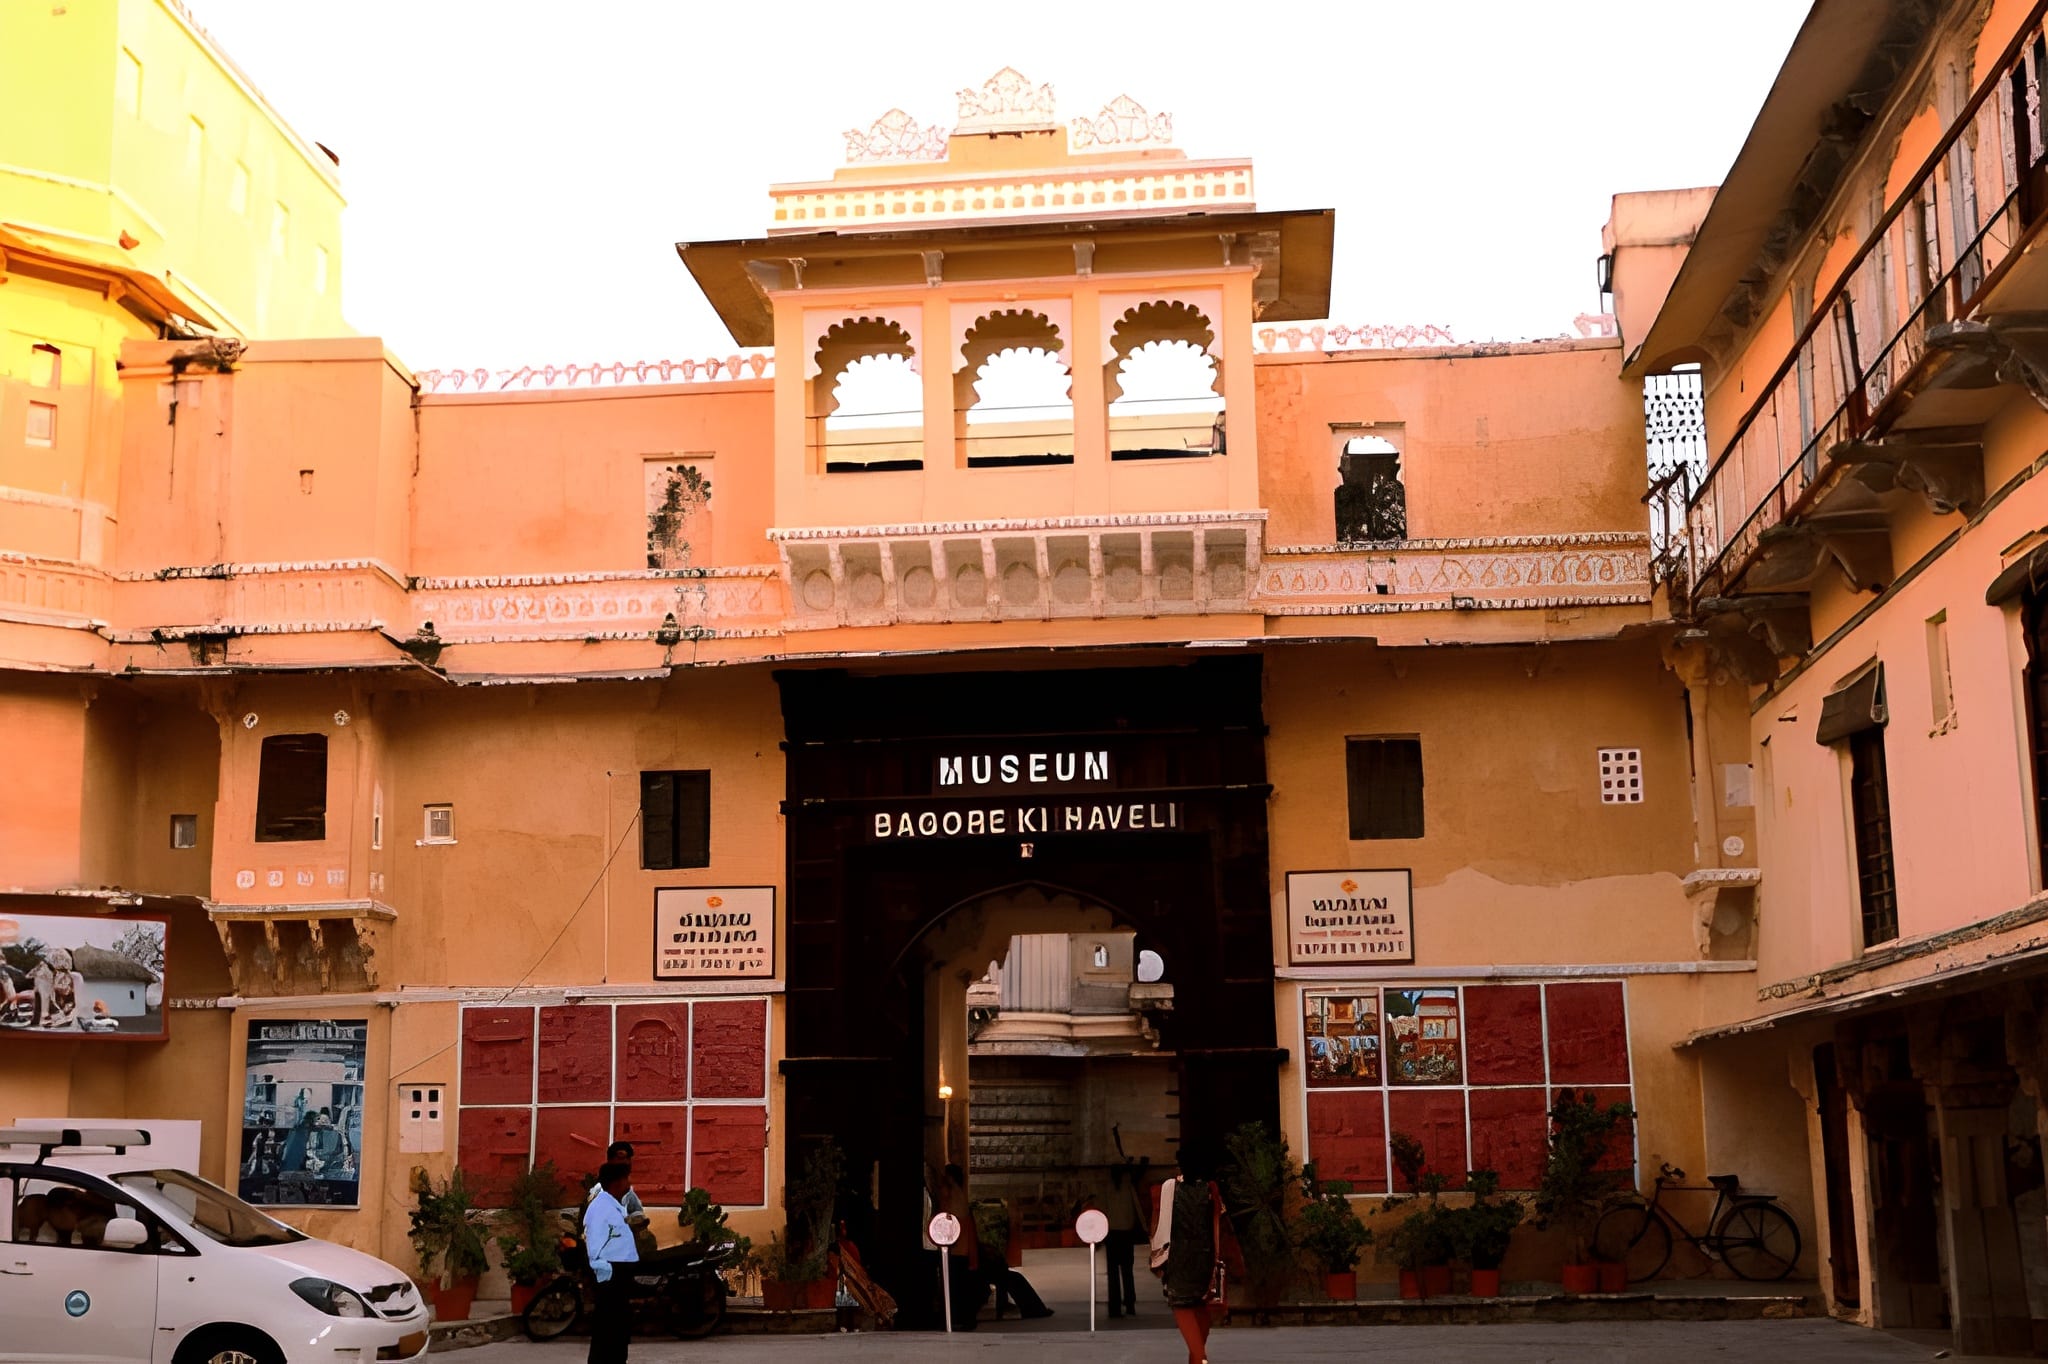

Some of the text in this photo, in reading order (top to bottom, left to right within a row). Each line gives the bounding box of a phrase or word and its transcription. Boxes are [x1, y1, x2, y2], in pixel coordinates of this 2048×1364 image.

[939, 750, 1109, 786] MUSEUM
[1017, 807, 1048, 833] KI
[1065, 802, 1176, 831] HAVELI
